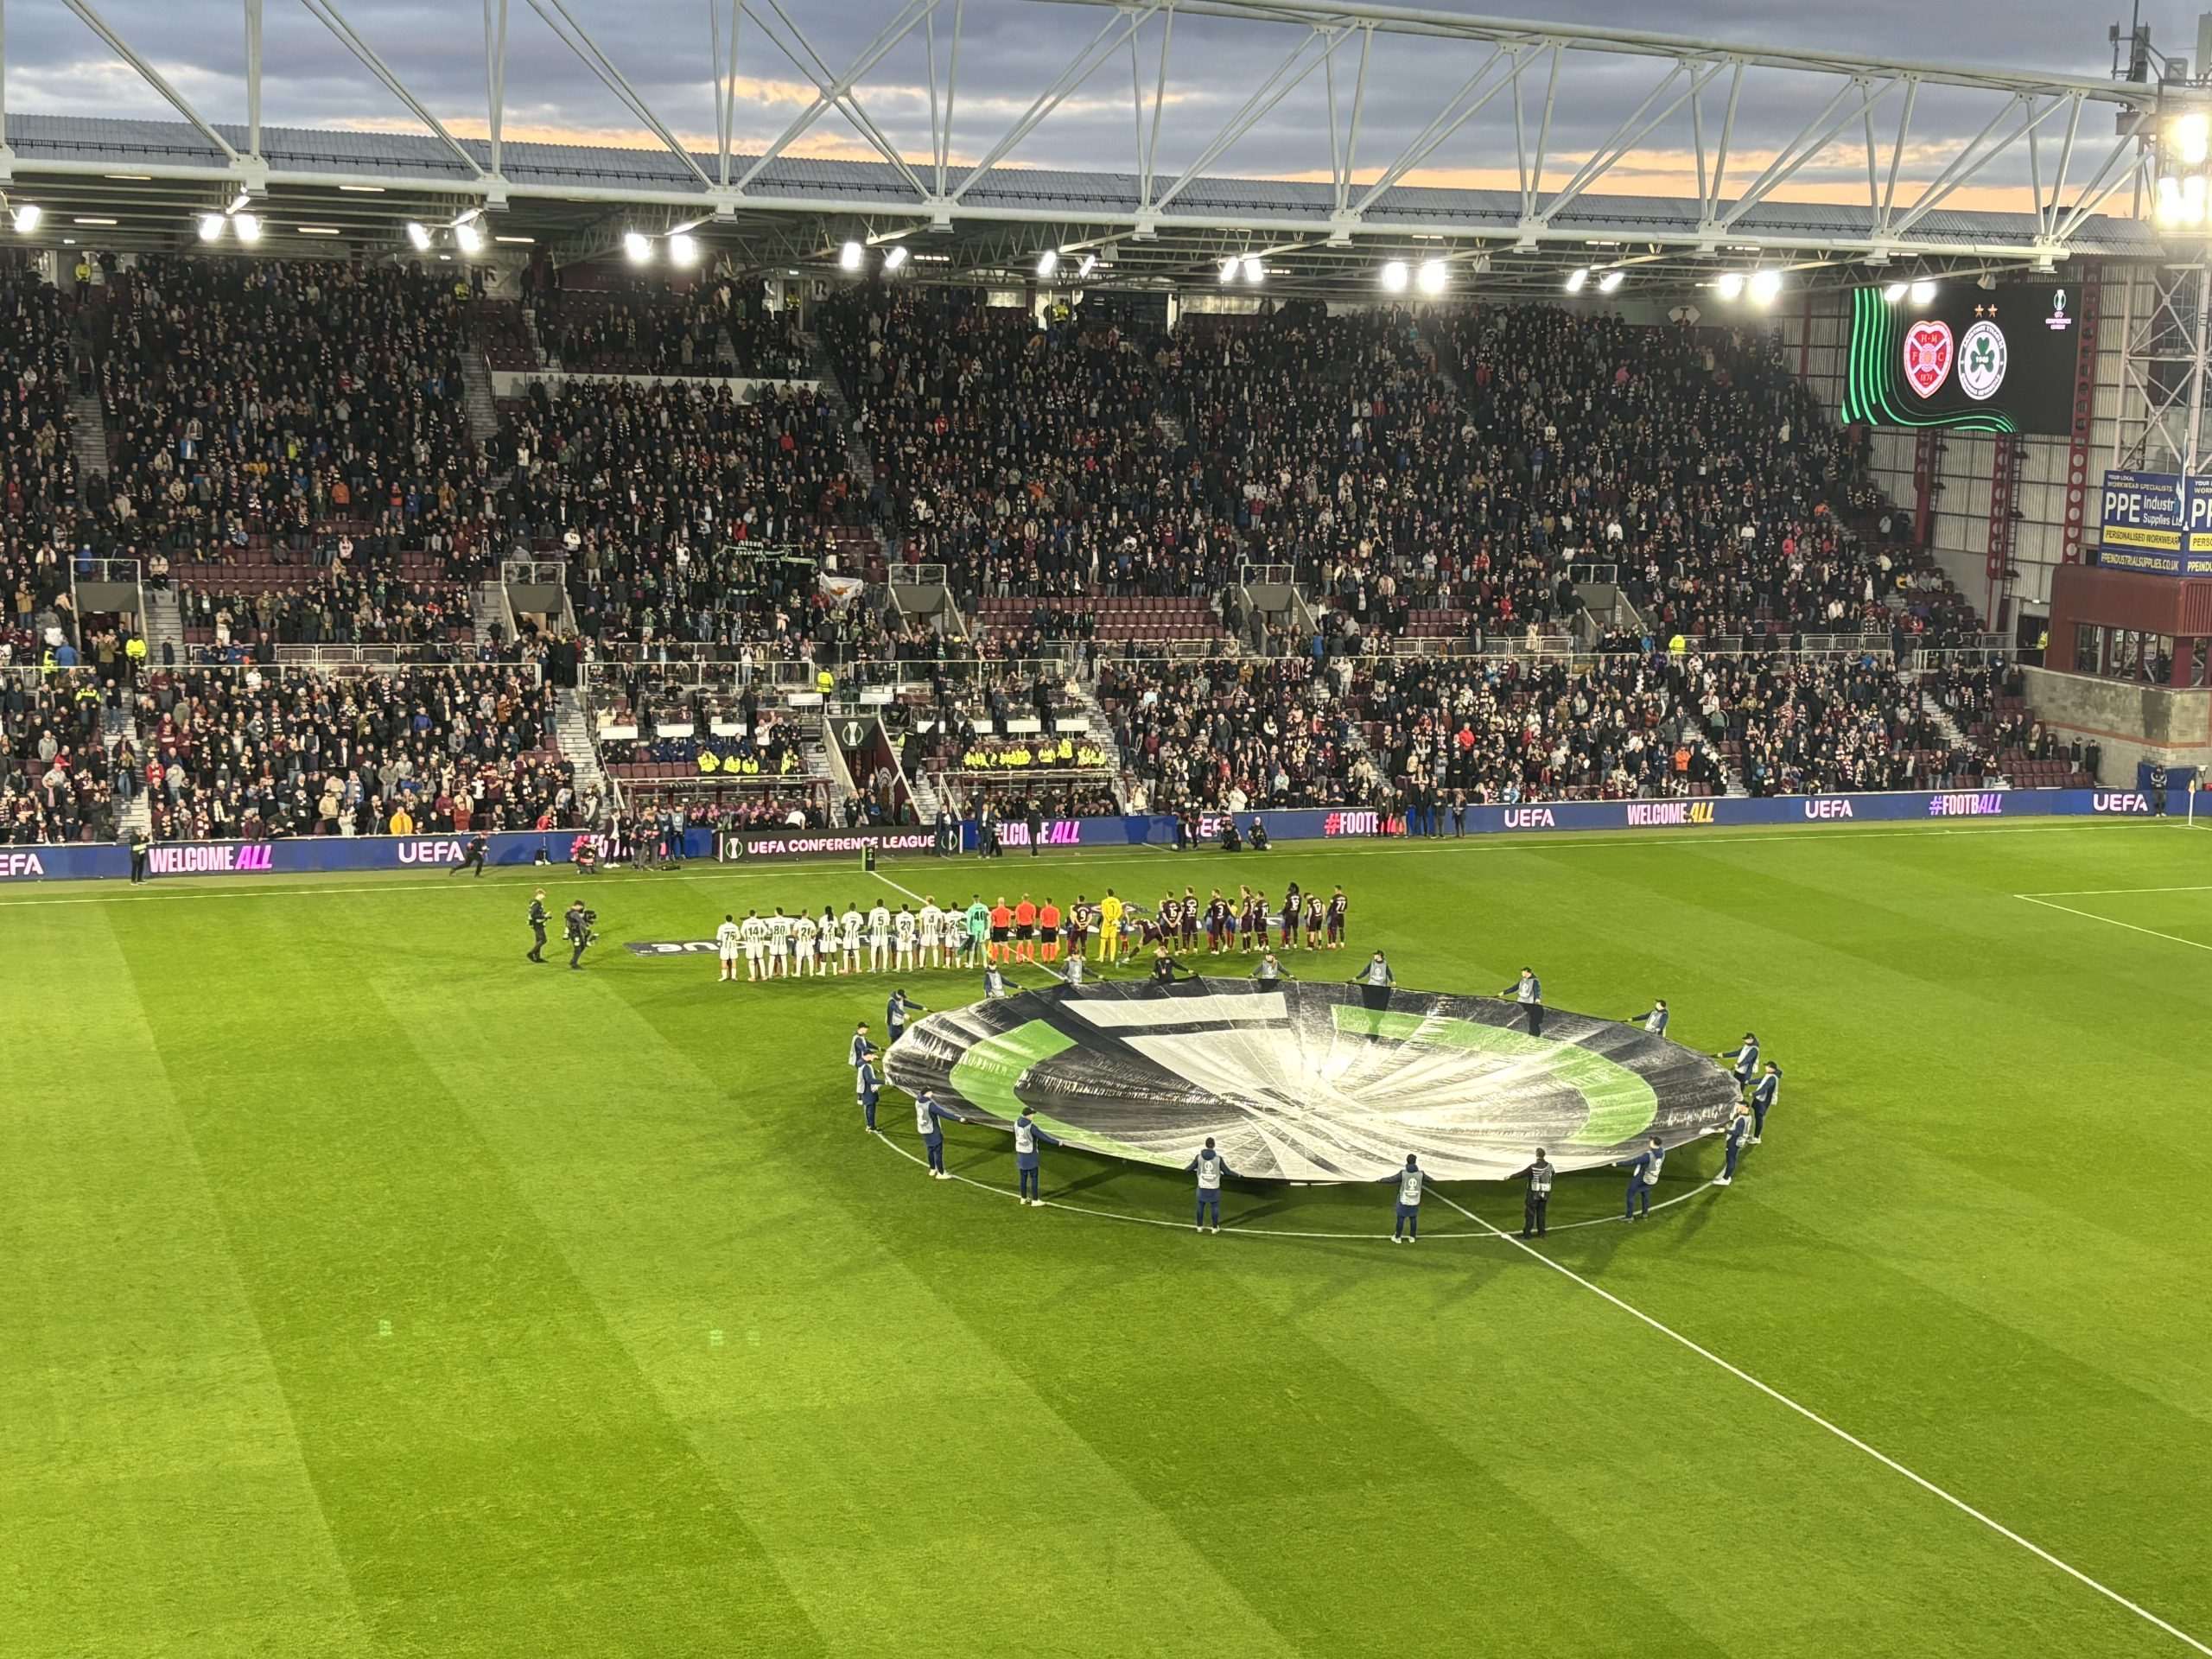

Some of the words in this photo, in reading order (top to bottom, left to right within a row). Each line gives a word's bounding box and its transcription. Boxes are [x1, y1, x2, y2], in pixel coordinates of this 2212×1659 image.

[2104, 491, 2142, 524] PPE
[2143, 512, 2171, 526] Supplies
[2105, 530, 2145, 543] PERSONALISED
[1805, 798, 1853, 818] UEFA
[1929, 793, 2003, 816] #FOOTBALL
[2093, 793, 2149, 812] UEFA
[1504, 808, 1555, 828] UEFA
[1627, 803, 1688, 825] WELCOME
[1688, 802, 1714, 823] ALL
[1050, 820, 1081, 844] ALL
[398, 841, 465, 863] UEFA
[747, 840, 786, 855] UEFA
[788, 836, 879, 853] CONFERENCE
[882, 835, 936, 849] LEAGUE
[148, 846, 234, 873] WELCOME
[234, 844, 273, 870] ALL
[877, 916, 884, 926] 5
